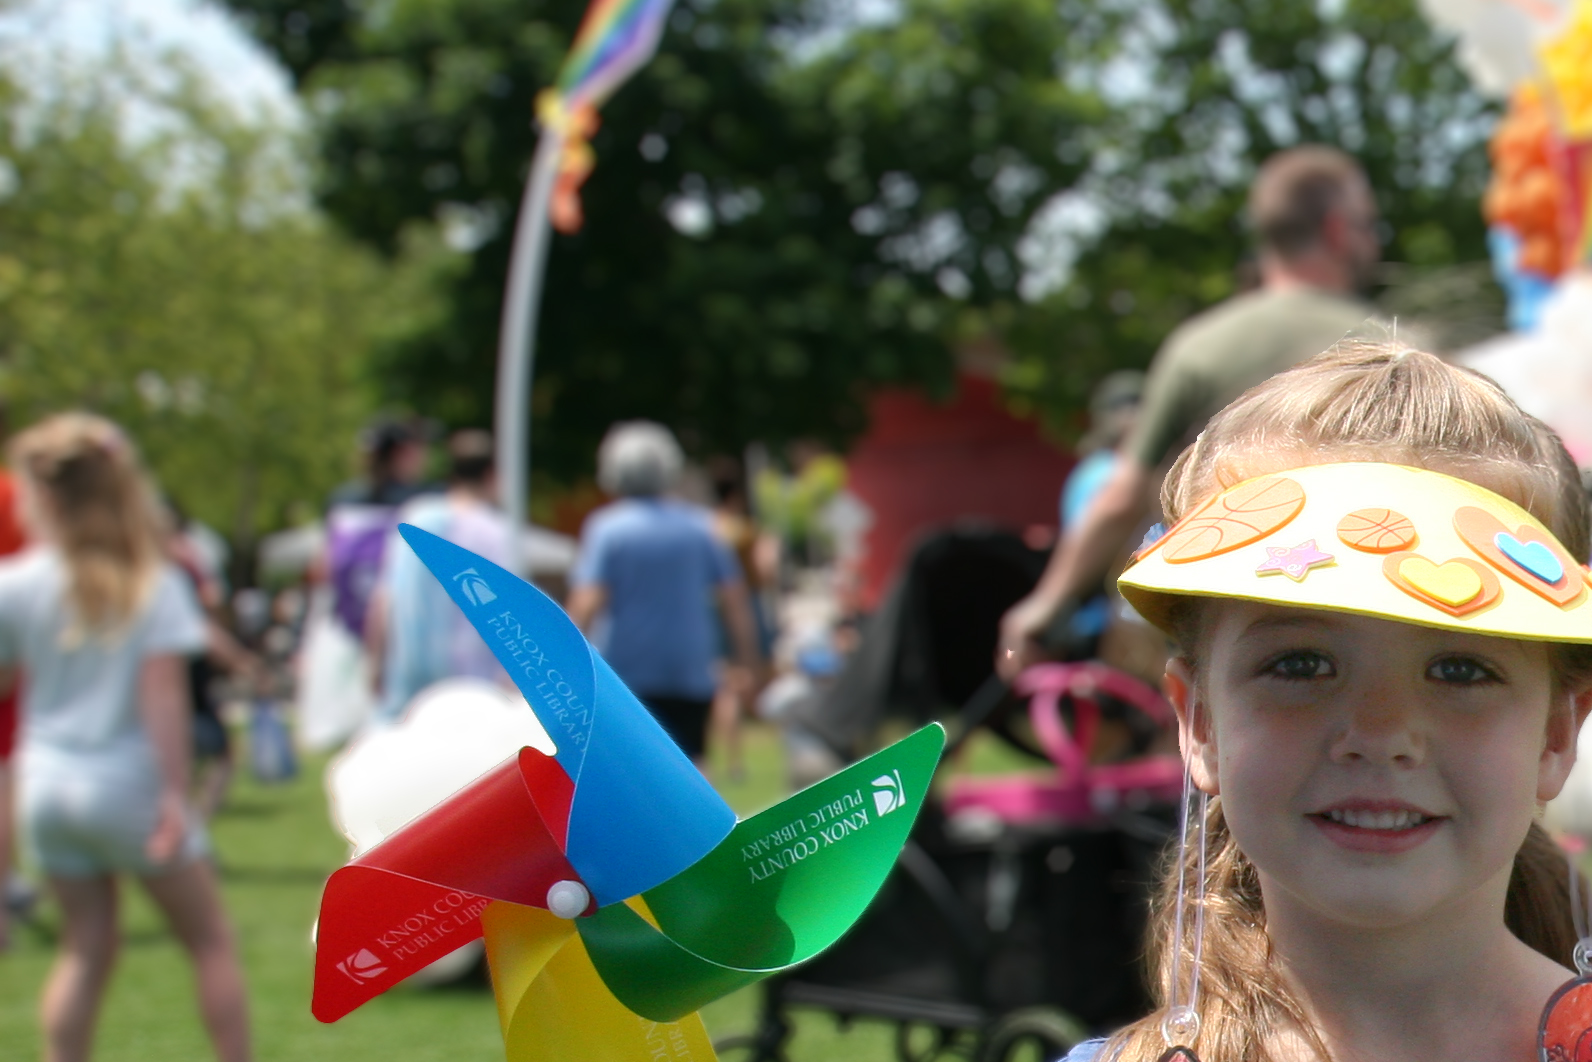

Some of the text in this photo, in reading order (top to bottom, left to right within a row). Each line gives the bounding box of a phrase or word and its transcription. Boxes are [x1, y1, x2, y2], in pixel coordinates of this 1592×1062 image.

[487, 617, 586, 752] PUBLIC LIBRAR
[500, 611, 593, 726] KNOX COUN
[741, 789, 864, 862] PUBLIC LIBRARY
[749, 808, 869, 884] KNOX COUNTY
[376, 891, 476, 948] KNOX COU
[392, 920, 455, 960] PUBLIC
